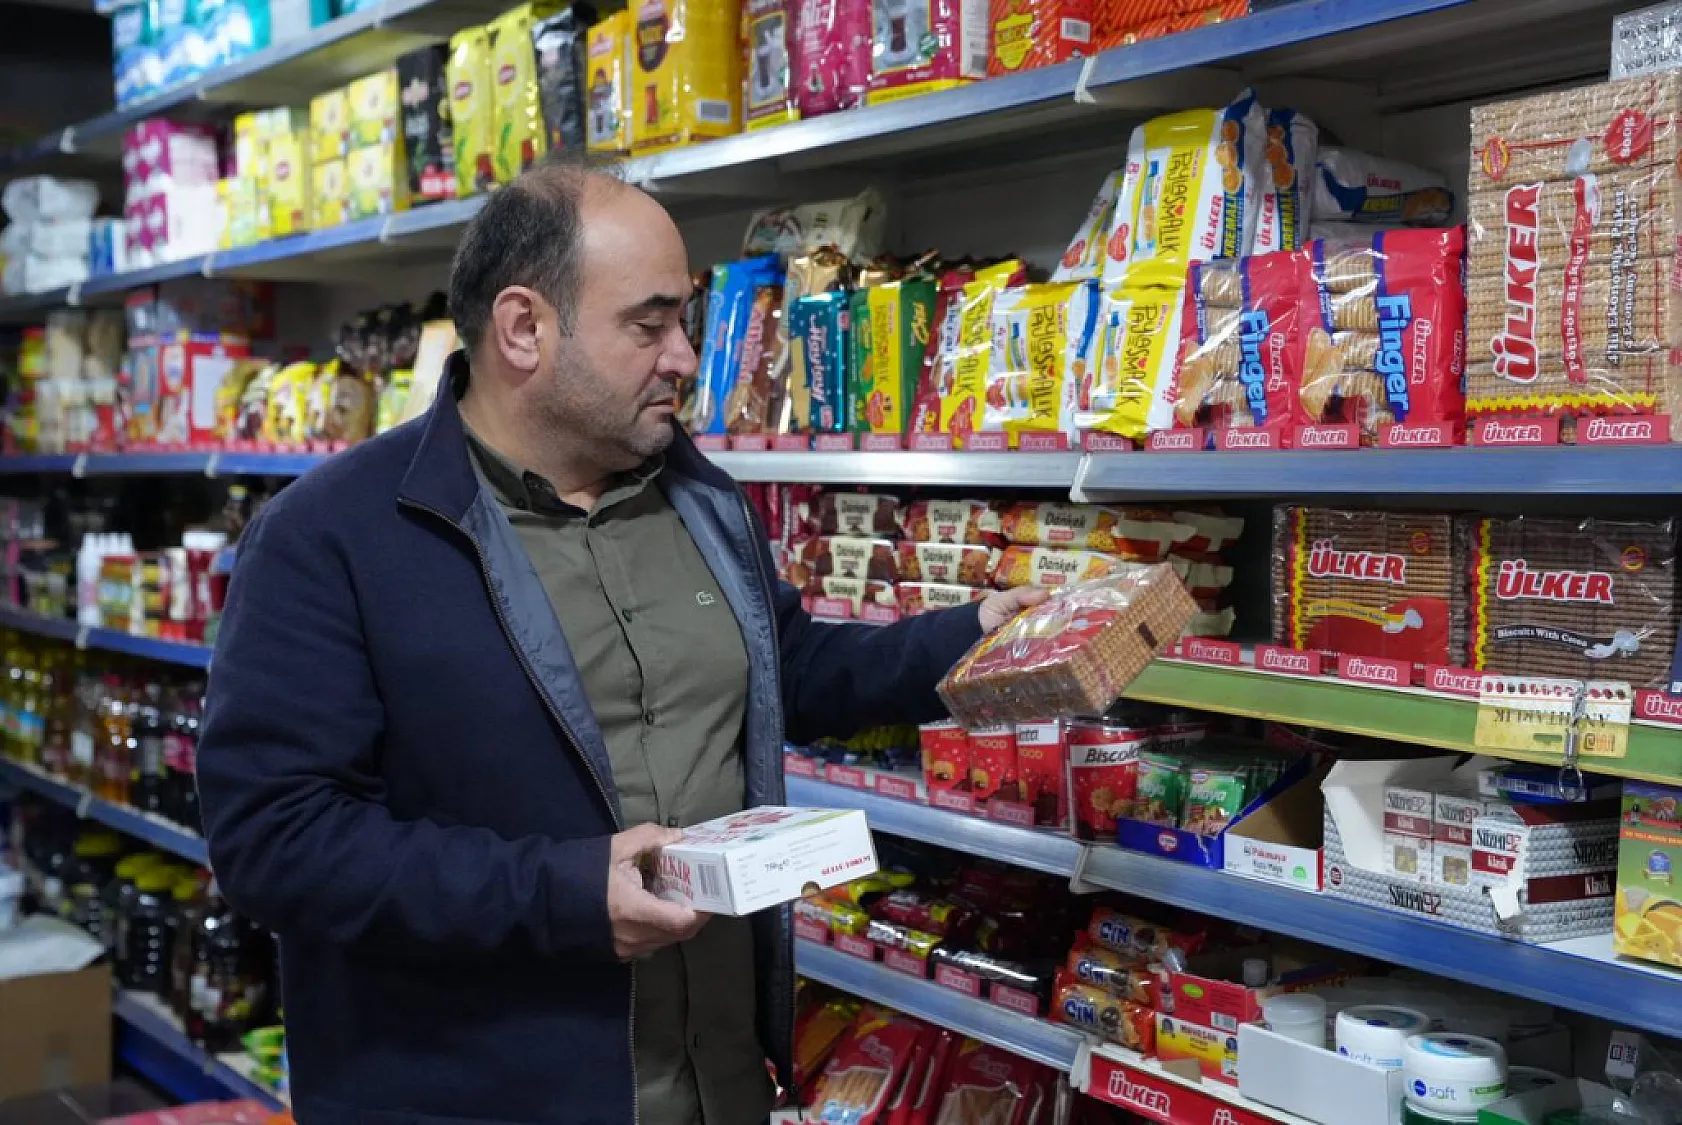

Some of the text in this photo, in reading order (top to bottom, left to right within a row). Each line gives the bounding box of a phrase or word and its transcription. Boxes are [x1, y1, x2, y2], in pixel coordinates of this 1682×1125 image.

[1490, 180, 1544, 384] ÜLKER
[1375, 294, 1411, 414] Finger
[1411, 318, 1432, 384] ÜLKER
[1239, 310, 1271, 416] Finger
[1226, 430, 1270, 447] ÜLKER
[1302, 427, 1348, 446] ÜLKER
[1389, 425, 1440, 444] ÜLKER
[1482, 421, 1542, 442] ÜLKER
[1587, 418, 1651, 440] ÜLKER
[1153, 433, 1193, 449] ÜLKER
[1045, 511, 1086, 529] Dankek
[1038, 555, 1078, 573] Dankek
[1308, 538, 1406, 584] ÜLKER
[1496, 558, 1614, 605] ÜLKER
[1189, 641, 1233, 662] ÜLKER
[1263, 648, 1310, 671] ÜLKER
[1348, 657, 1398, 683] ÜLKER
[1644, 694, 1682, 718] ÜLK
[1107, 1070, 1171, 1117] ÜLKER
